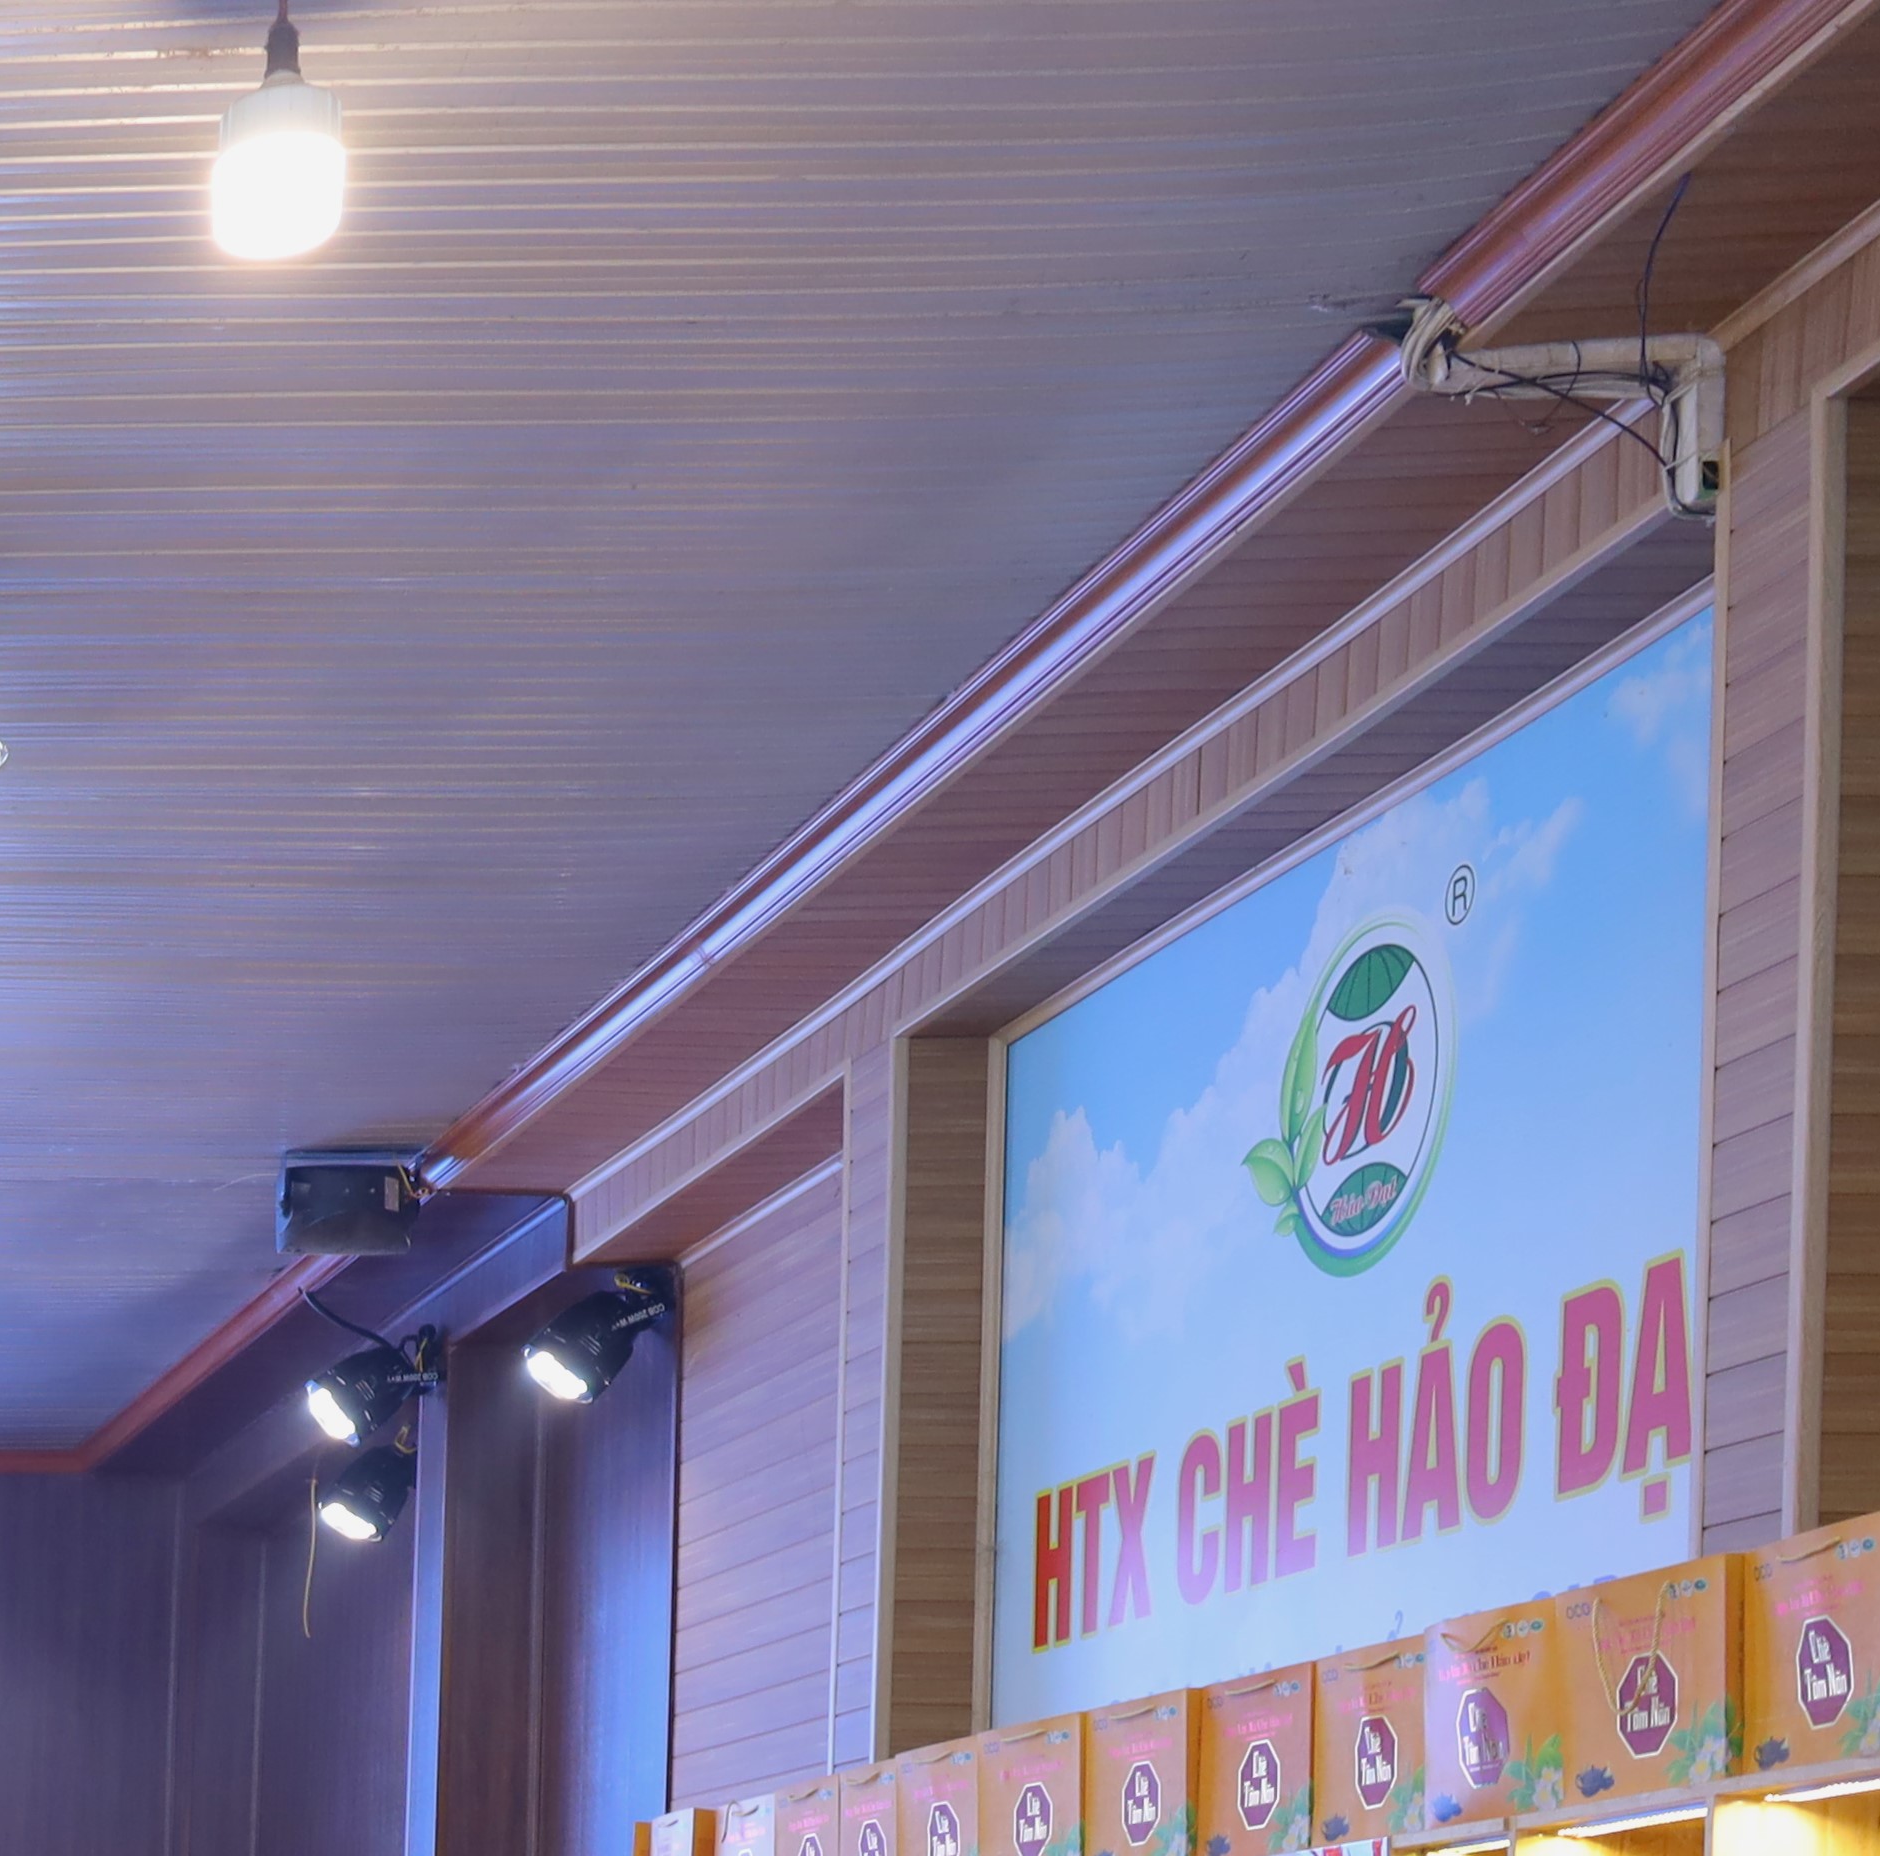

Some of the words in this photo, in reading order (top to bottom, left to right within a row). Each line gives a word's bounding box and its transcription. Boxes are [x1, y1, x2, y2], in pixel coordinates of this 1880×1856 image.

[1032, 1450, 1156, 1653] HTX
[1175, 1355, 1320, 1606] CHÈ
[1346, 1276, 1527, 1558] HẢO
